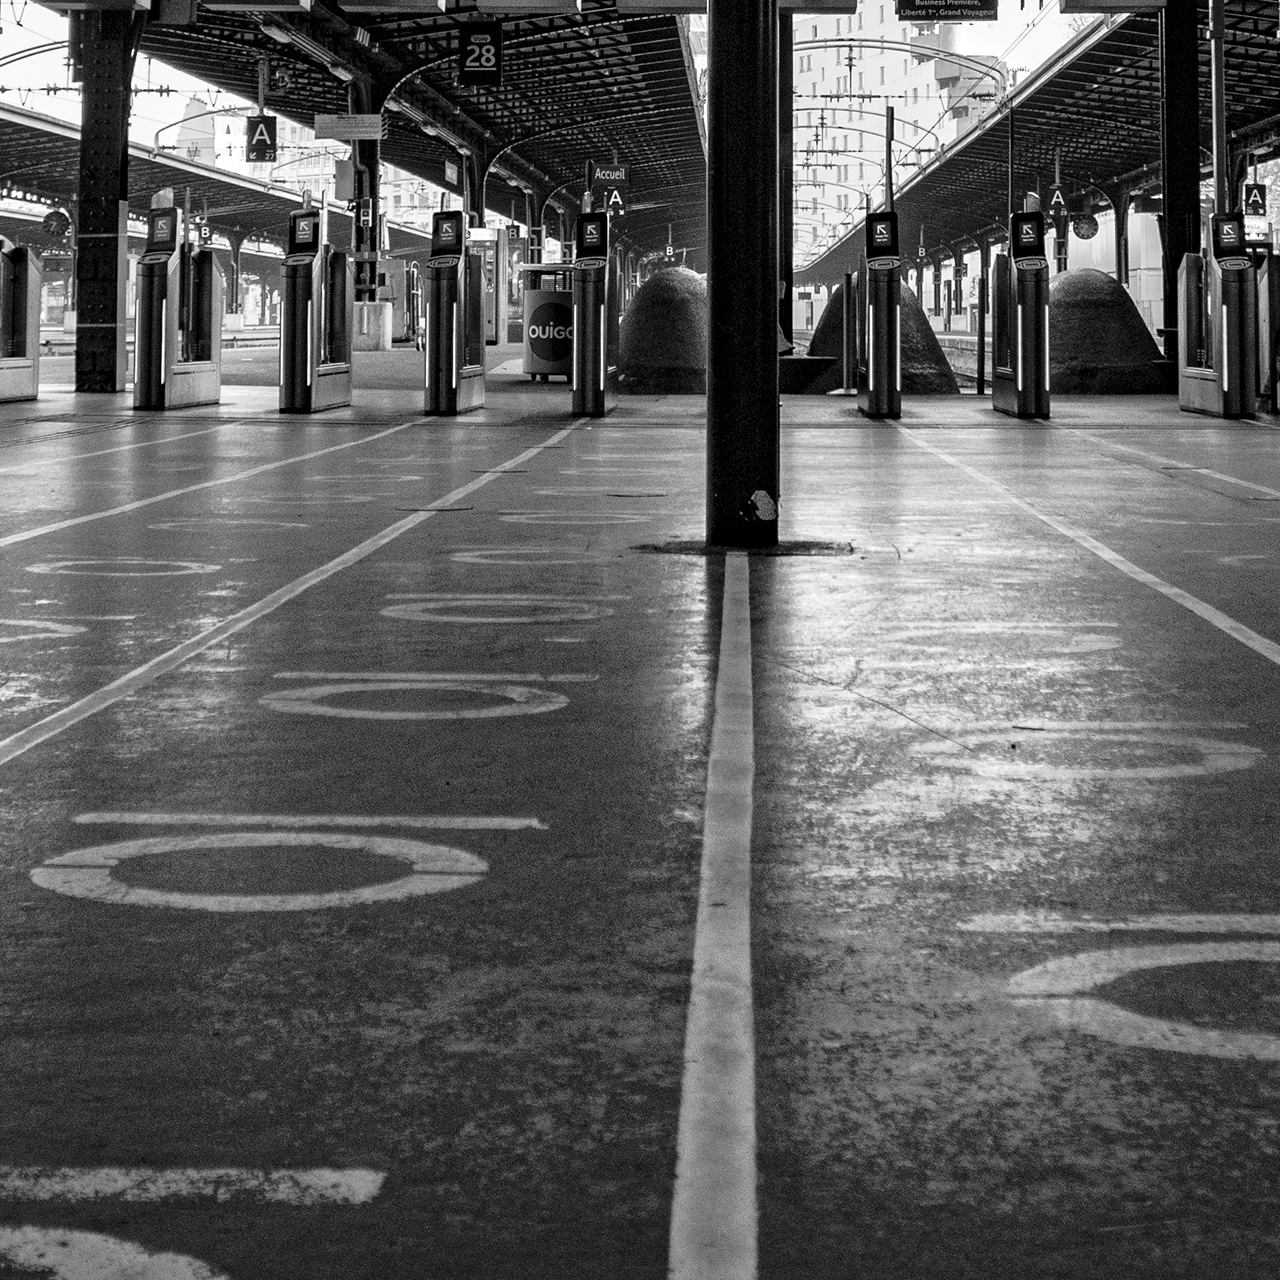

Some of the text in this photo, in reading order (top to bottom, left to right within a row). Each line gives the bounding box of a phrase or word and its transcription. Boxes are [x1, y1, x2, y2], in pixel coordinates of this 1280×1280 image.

[901, 8, 926, 16] Liberté
[939, 8, 962, 16] Grand
[962, 8, 995, 17] Voyageur
[466, 45, 496, 66] 28
[252, 123, 271, 145] A
[594, 167, 626, 180] Accueil
[609, 190, 623, 205] A
[1051, 190, 1065, 205] A
[1248, 189, 1263, 204] A
[201, 226, 210, 237] B
[508, 228, 518, 239] B
[666, 246, 674, 256] B
[918, 247, 926, 257] B
